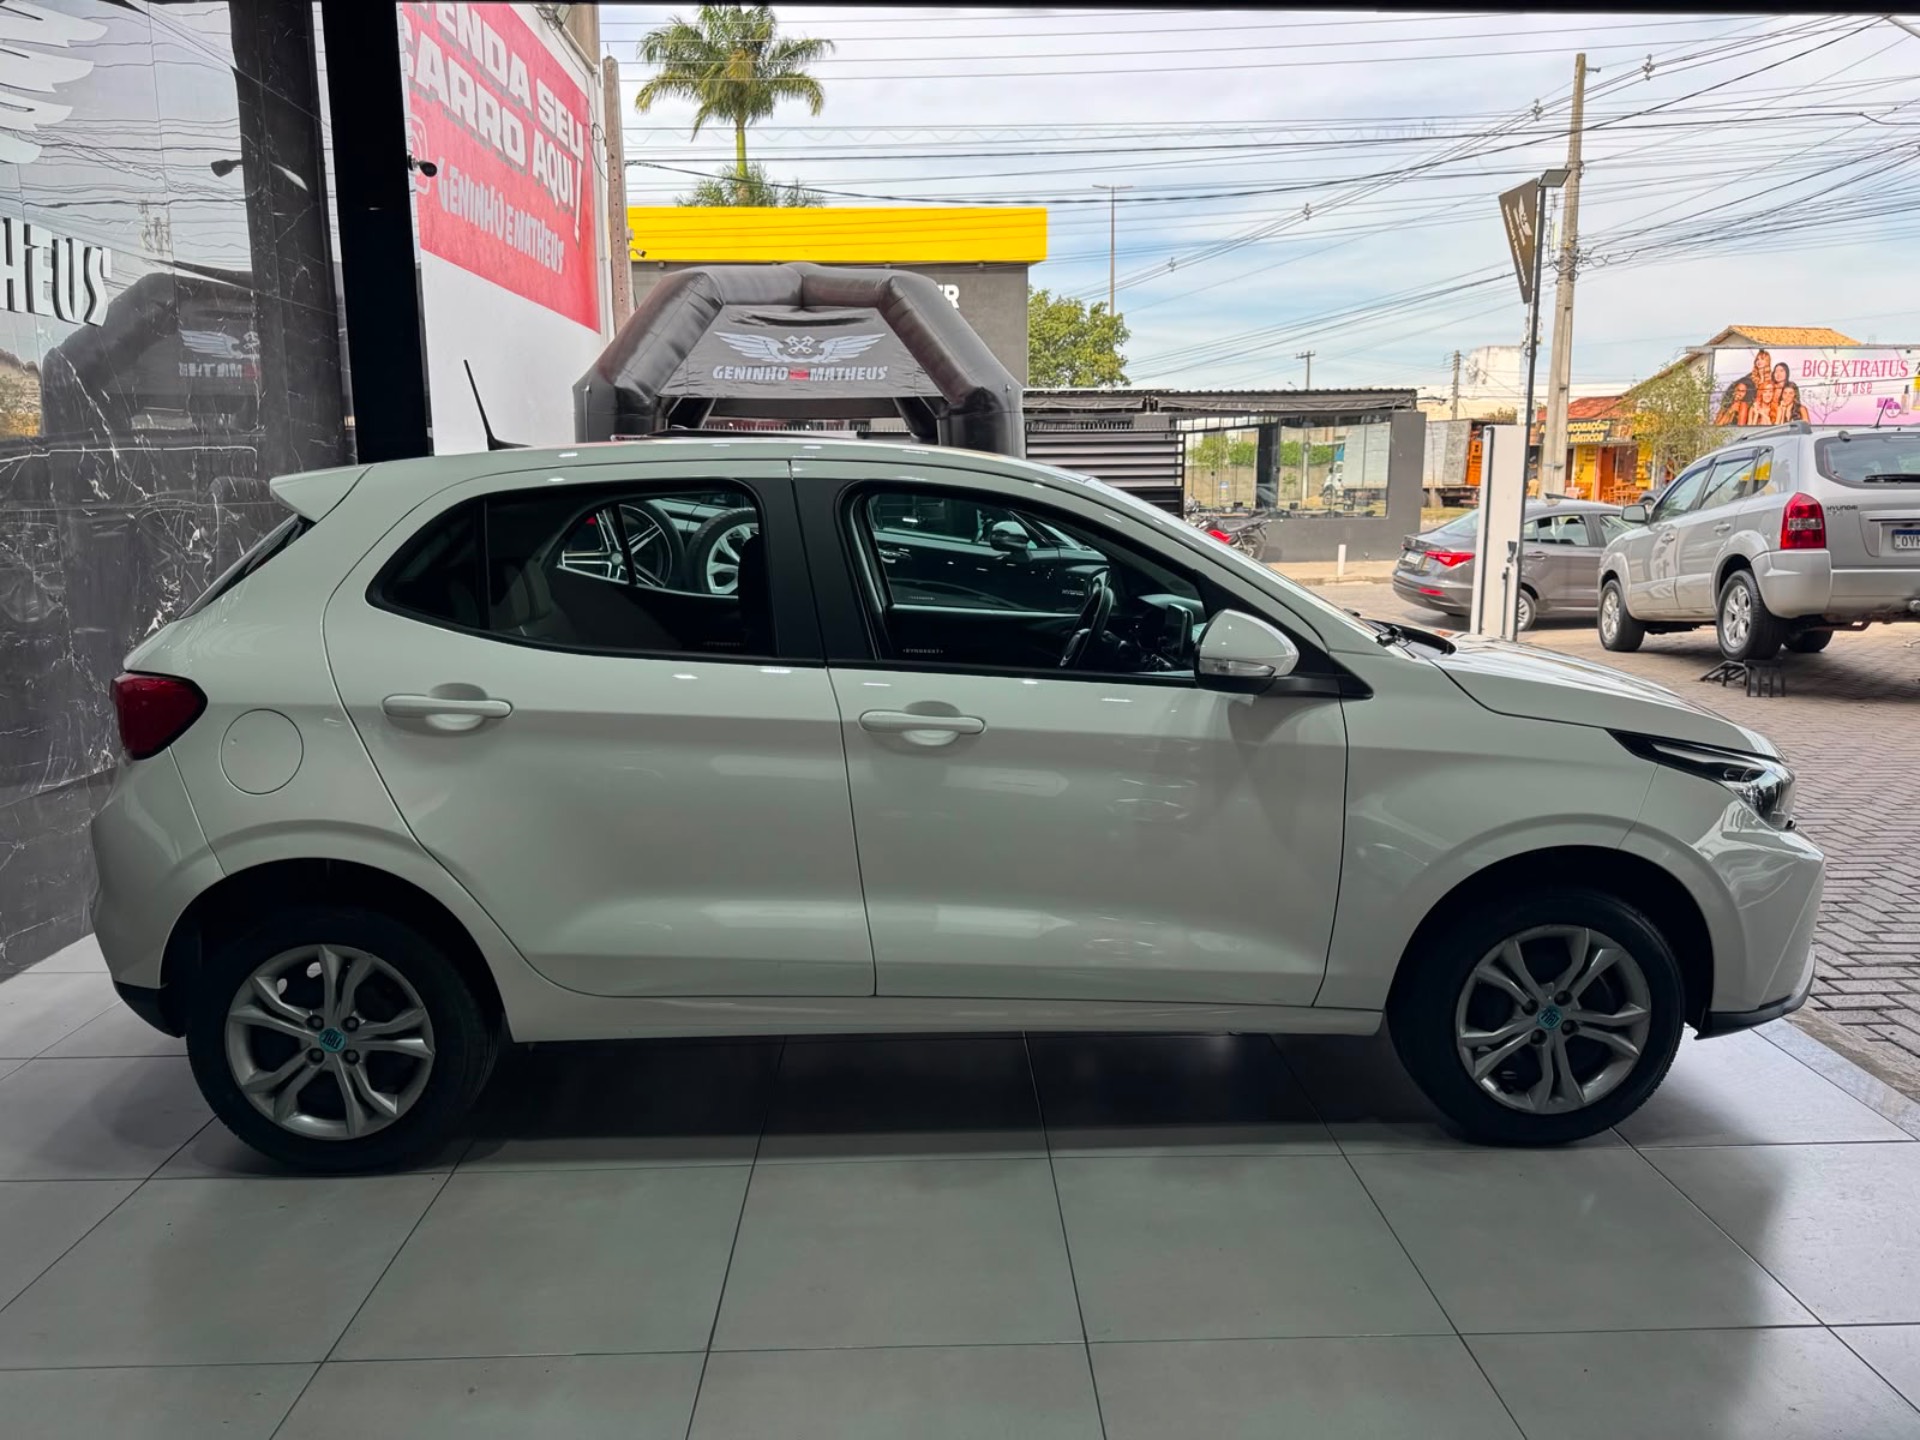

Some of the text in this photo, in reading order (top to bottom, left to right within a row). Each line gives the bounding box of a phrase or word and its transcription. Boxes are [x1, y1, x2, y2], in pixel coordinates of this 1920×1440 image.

[421, 4, 584, 160] ENDA SEU
[532, 128, 583, 244] AQUI!
[937, 284, 960, 309] R
[712, 365, 788, 381] GENINHO
[809, 366, 888, 381] MATHEUS
